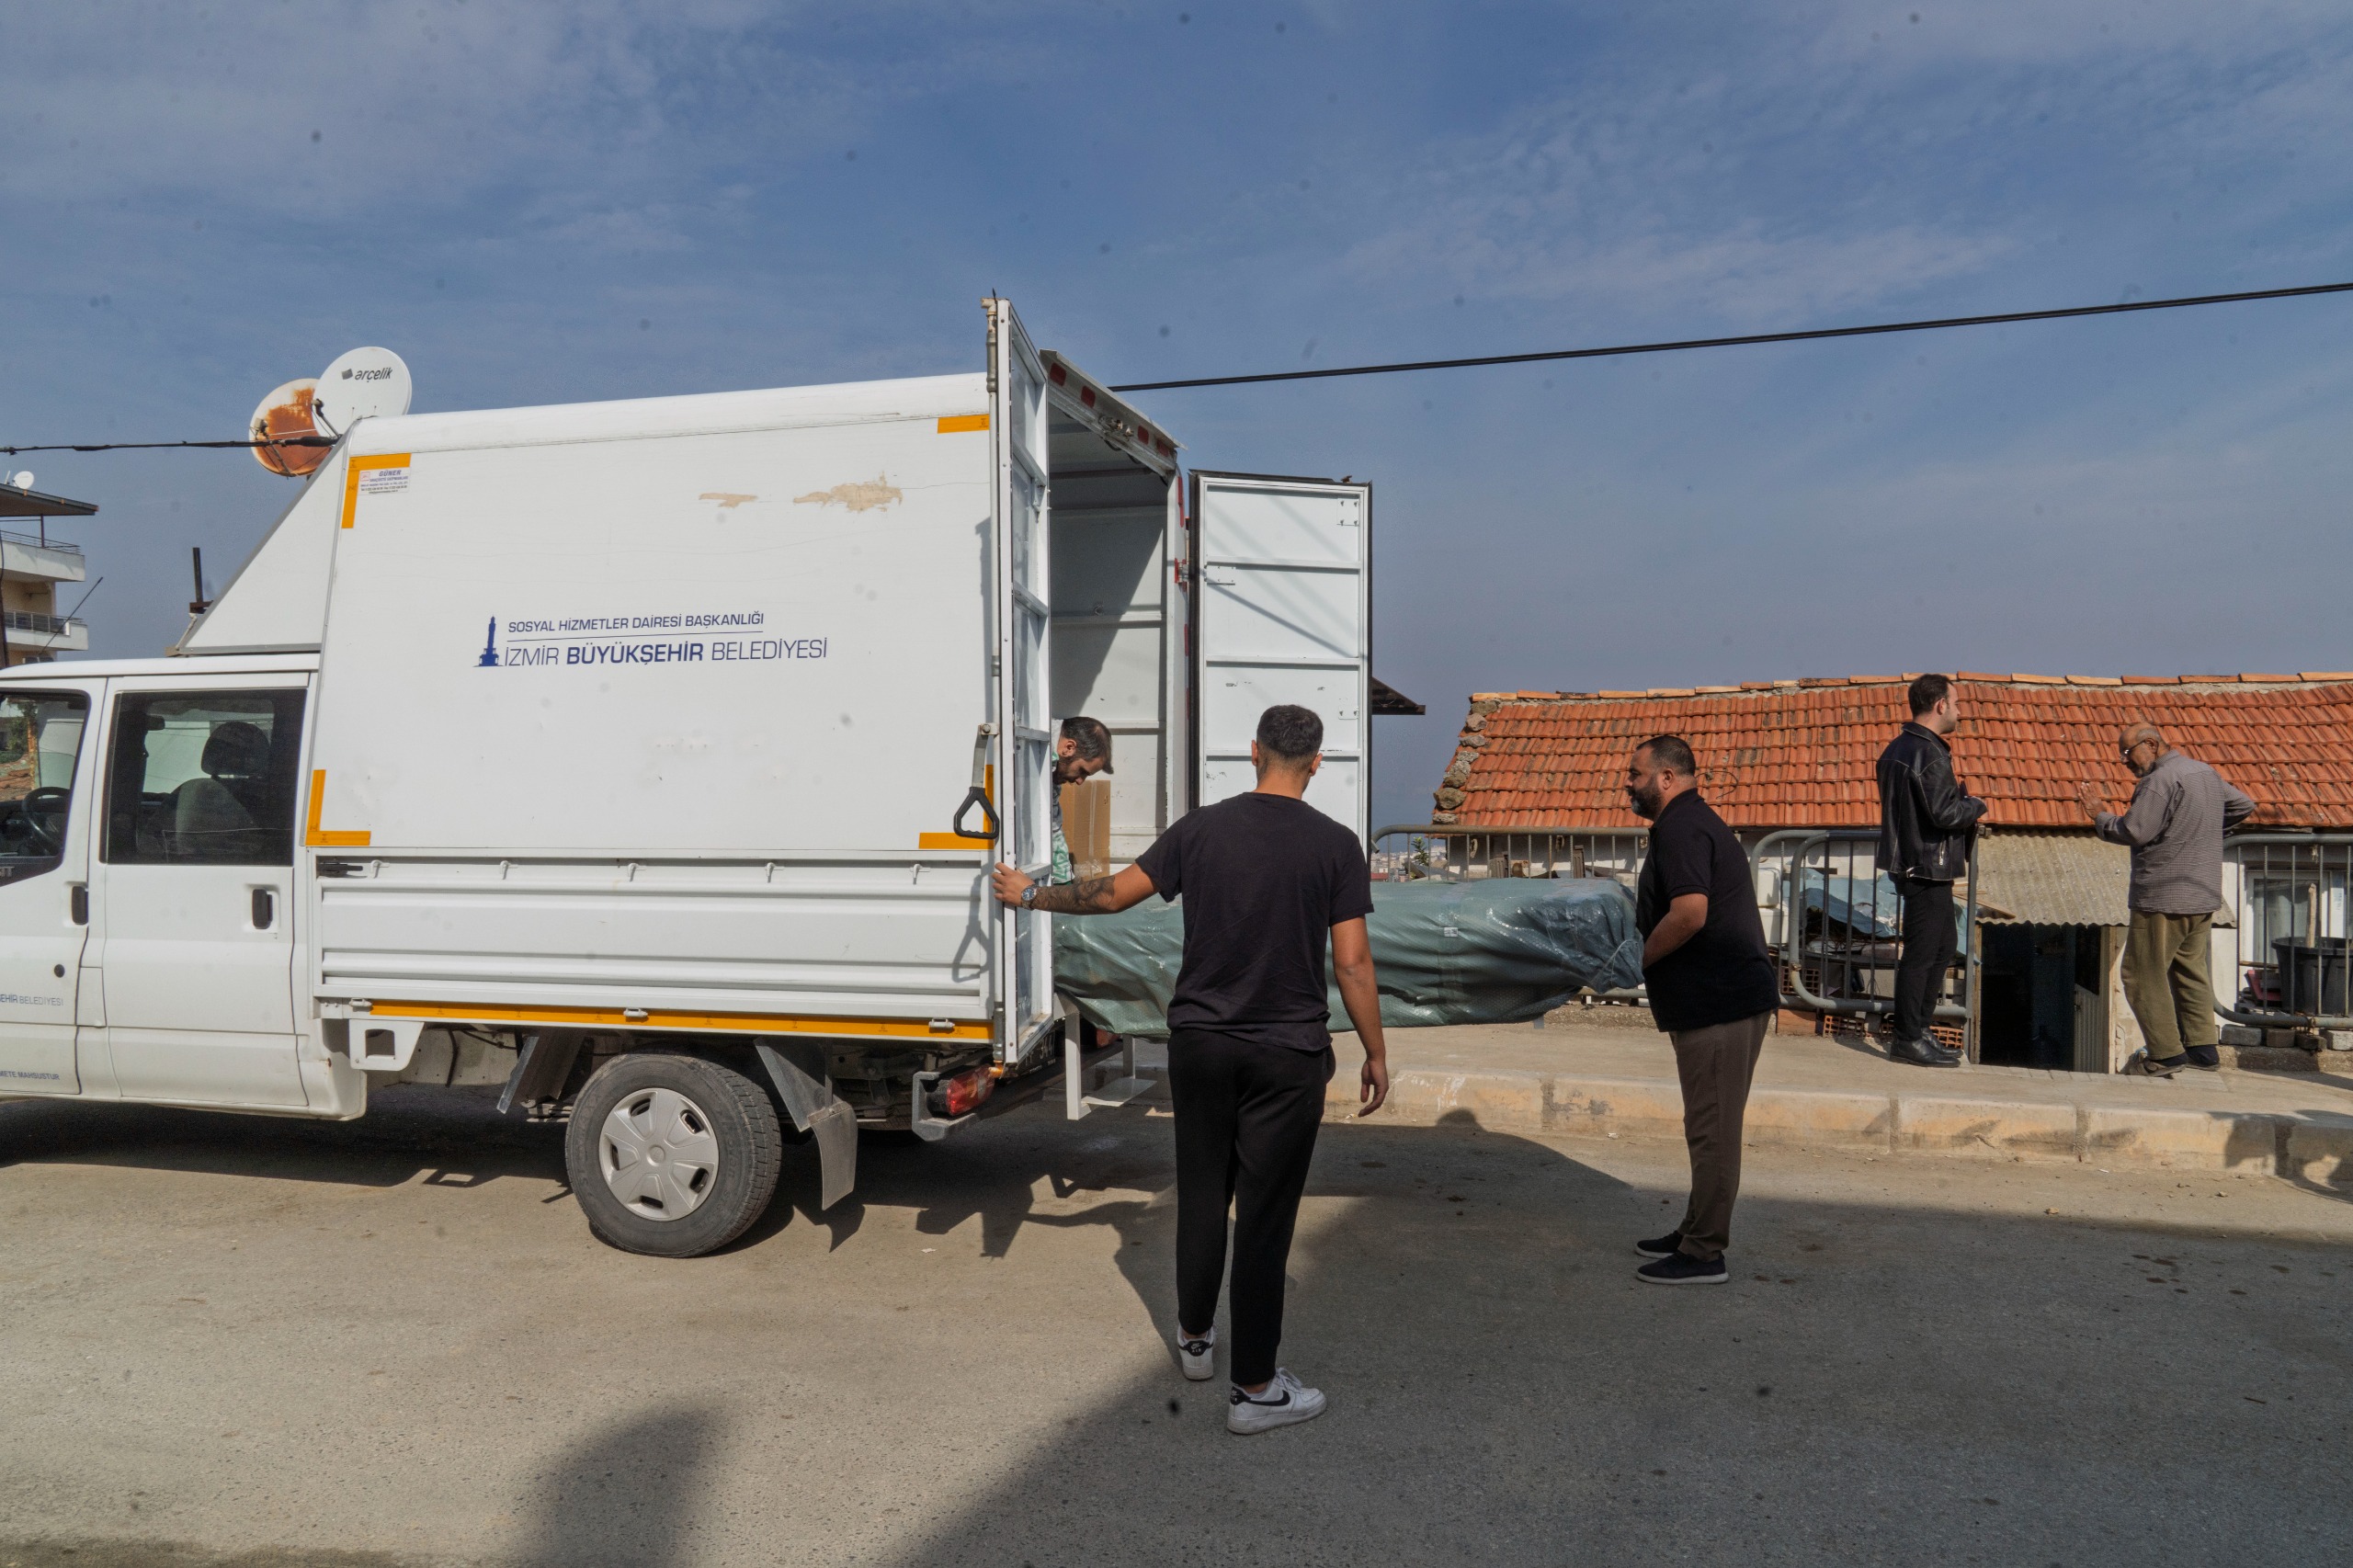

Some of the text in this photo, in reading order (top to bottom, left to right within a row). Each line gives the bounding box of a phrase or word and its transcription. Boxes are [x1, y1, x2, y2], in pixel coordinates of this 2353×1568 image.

[355, 368, 392, 382] arçelik
[379, 469, 402, 477] GÜNER
[508, 610, 764, 632] SOSYAL HİZMETLER DAİRESİ BAŞKANLIĞI
[505, 637, 827, 666] İZMİR BÜYÜKŞEHİR BELEDİYESİ
[0, 994, 18, 1004] EHİR
